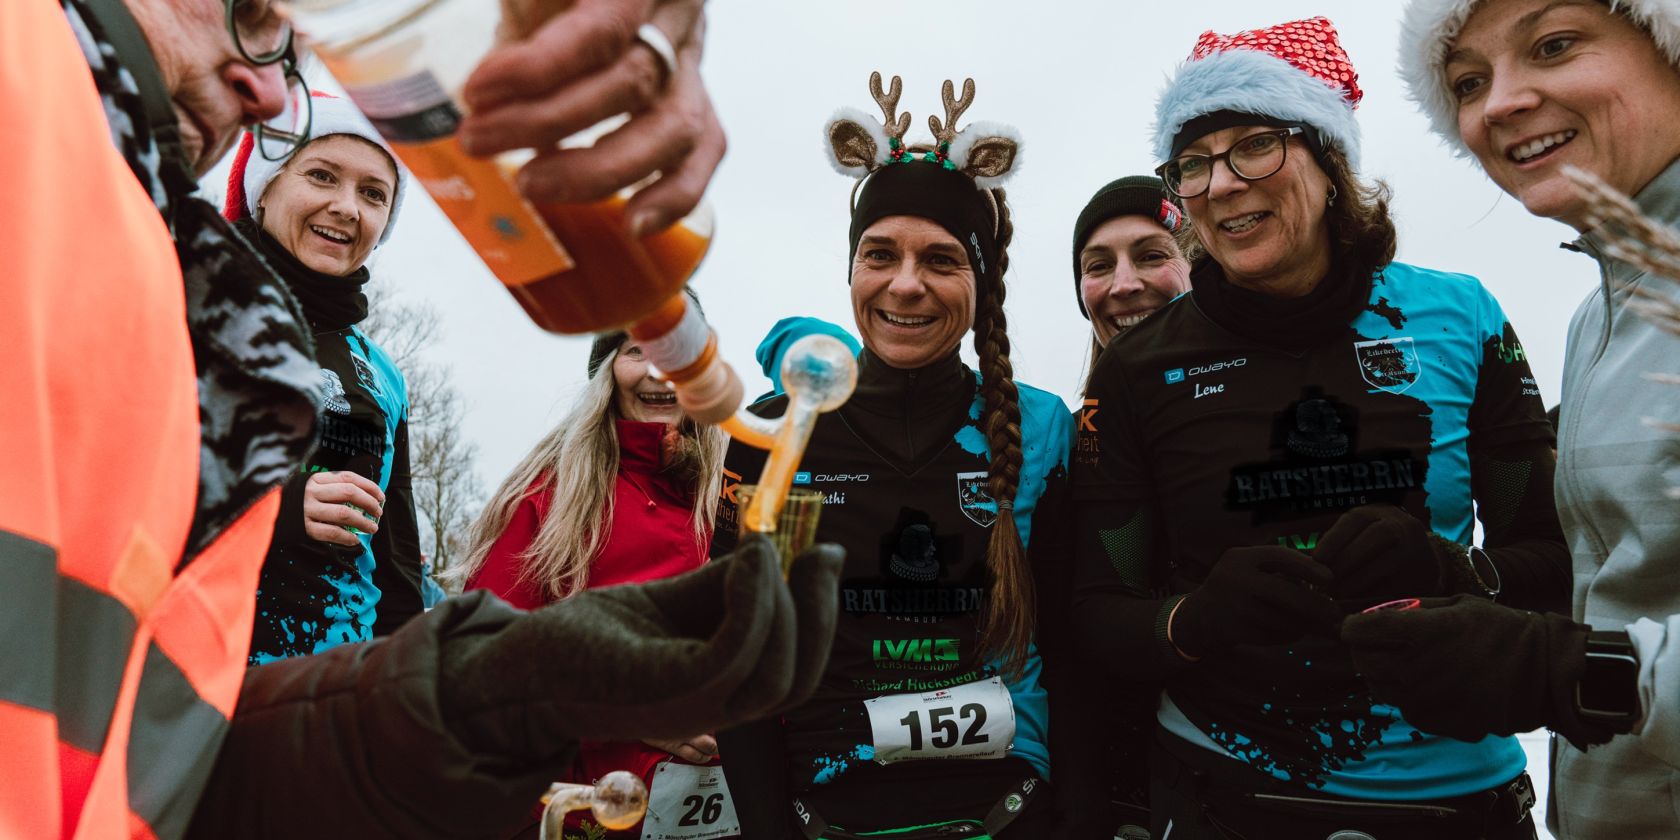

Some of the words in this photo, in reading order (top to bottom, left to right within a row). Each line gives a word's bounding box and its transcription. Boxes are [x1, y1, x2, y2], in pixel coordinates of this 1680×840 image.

[1193, 383, 1225, 399] Lene
[322, 415, 383, 459] HERRN
[1233, 457, 1416, 504] RATSHERRN
[842, 586, 985, 614] RATSHERRN
[872, 638, 932, 662] LVM
[899, 702, 989, 751] 152
[678, 792, 724, 827] 26
